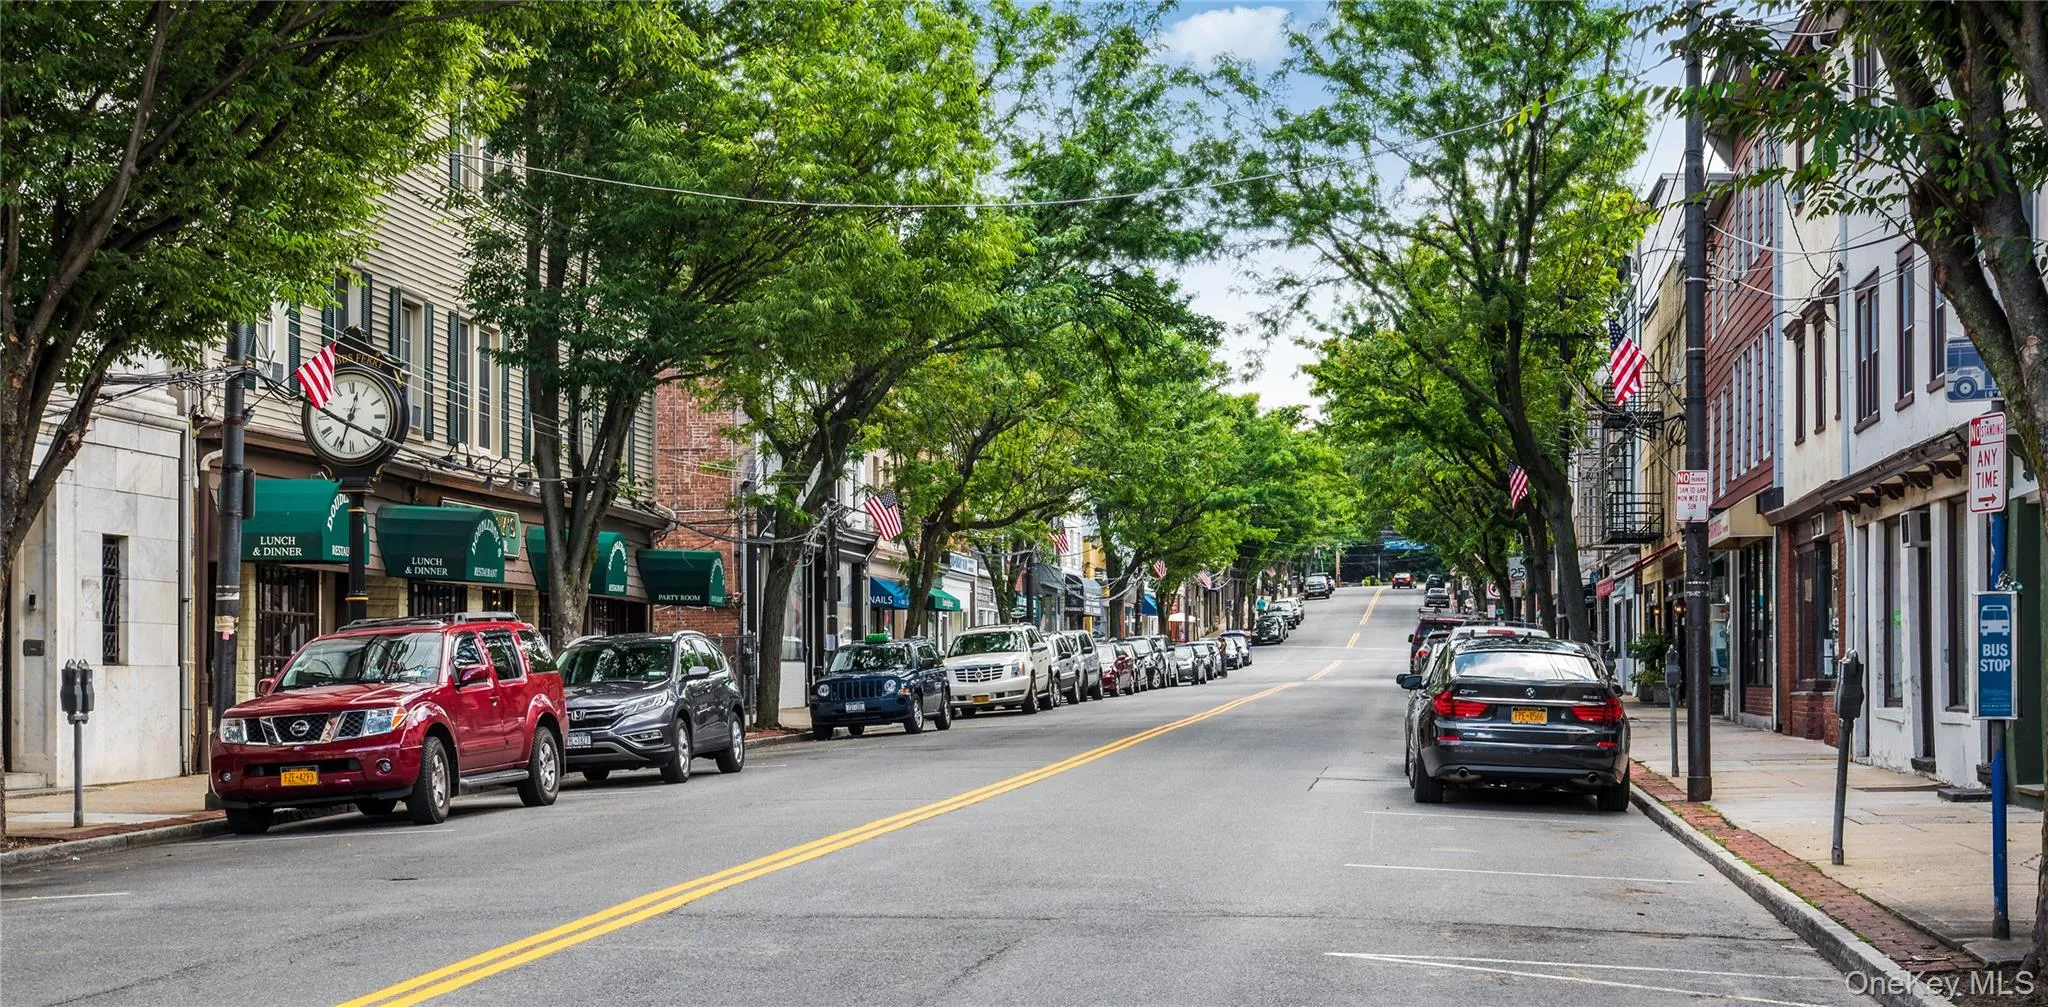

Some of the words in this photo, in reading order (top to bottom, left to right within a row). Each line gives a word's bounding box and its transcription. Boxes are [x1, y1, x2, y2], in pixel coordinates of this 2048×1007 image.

[356, 353, 381, 368] FERRY
[1971, 423, 1980, 442] NO
[1981, 423, 2003, 437] STANDING
[1977, 448, 1998, 468] ANY
[1677, 472, 1690, 483] NO
[1976, 470, 1998, 489] TIME
[260, 536, 296, 546] LUNCH
[253, 547, 261, 556] &
[263, 547, 302, 556] DINNER
[412, 557, 442, 566] LUNCH
[405, 566, 412, 575] &
[414, 567, 448, 576] DINNER
[1510, 567, 1526, 579] 25
[870, 596, 893, 605] NAILS
[1982, 643, 2009, 657] BUS
[1980, 659, 2011, 672] STOP
